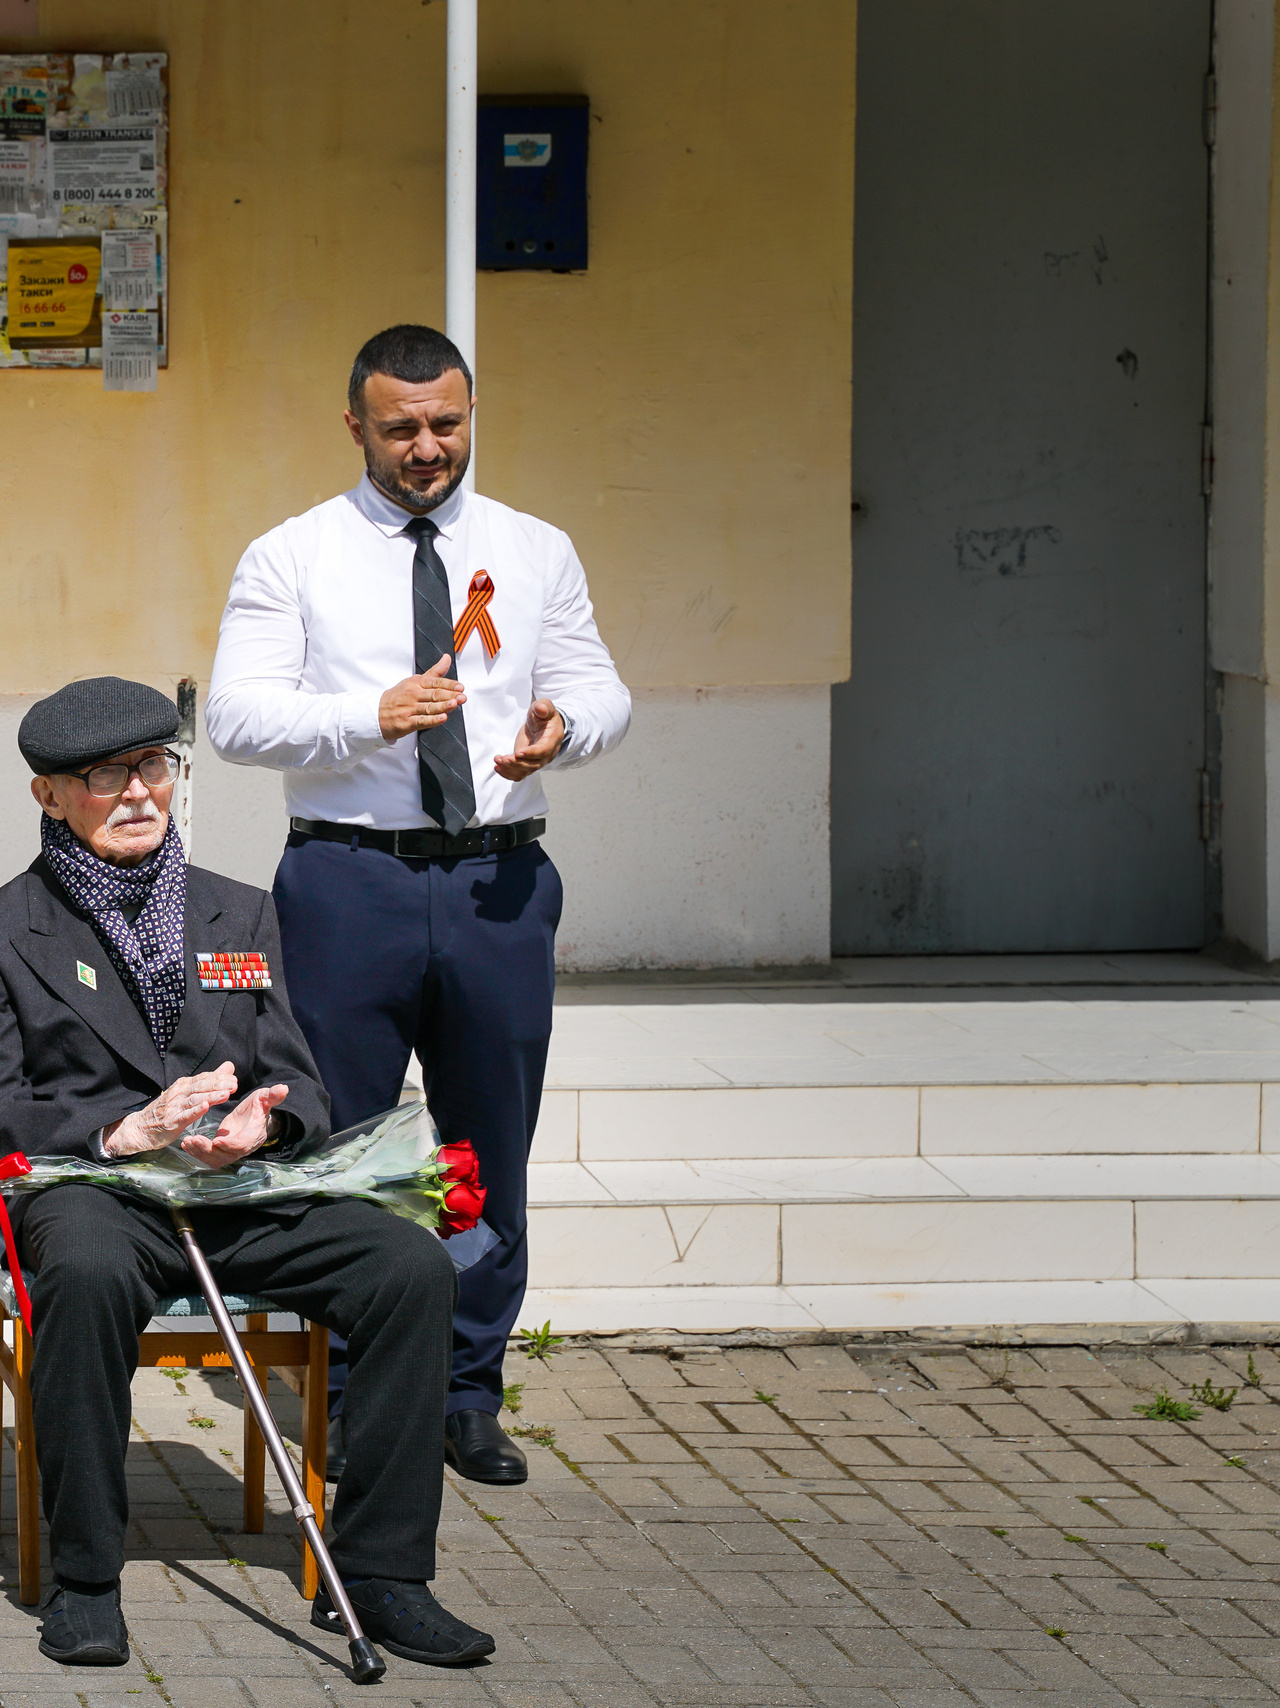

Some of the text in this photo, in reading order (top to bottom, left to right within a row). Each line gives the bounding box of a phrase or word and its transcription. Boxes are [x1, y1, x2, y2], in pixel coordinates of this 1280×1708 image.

[53, 190, 61, 200] 8
[64, 189, 95, 202] (800)
[98, 189, 121, 199] 444
[124, 188, 132, 198] 8
[19, 275, 65, 286] Закажи
[19, 287, 53, 298] такси
